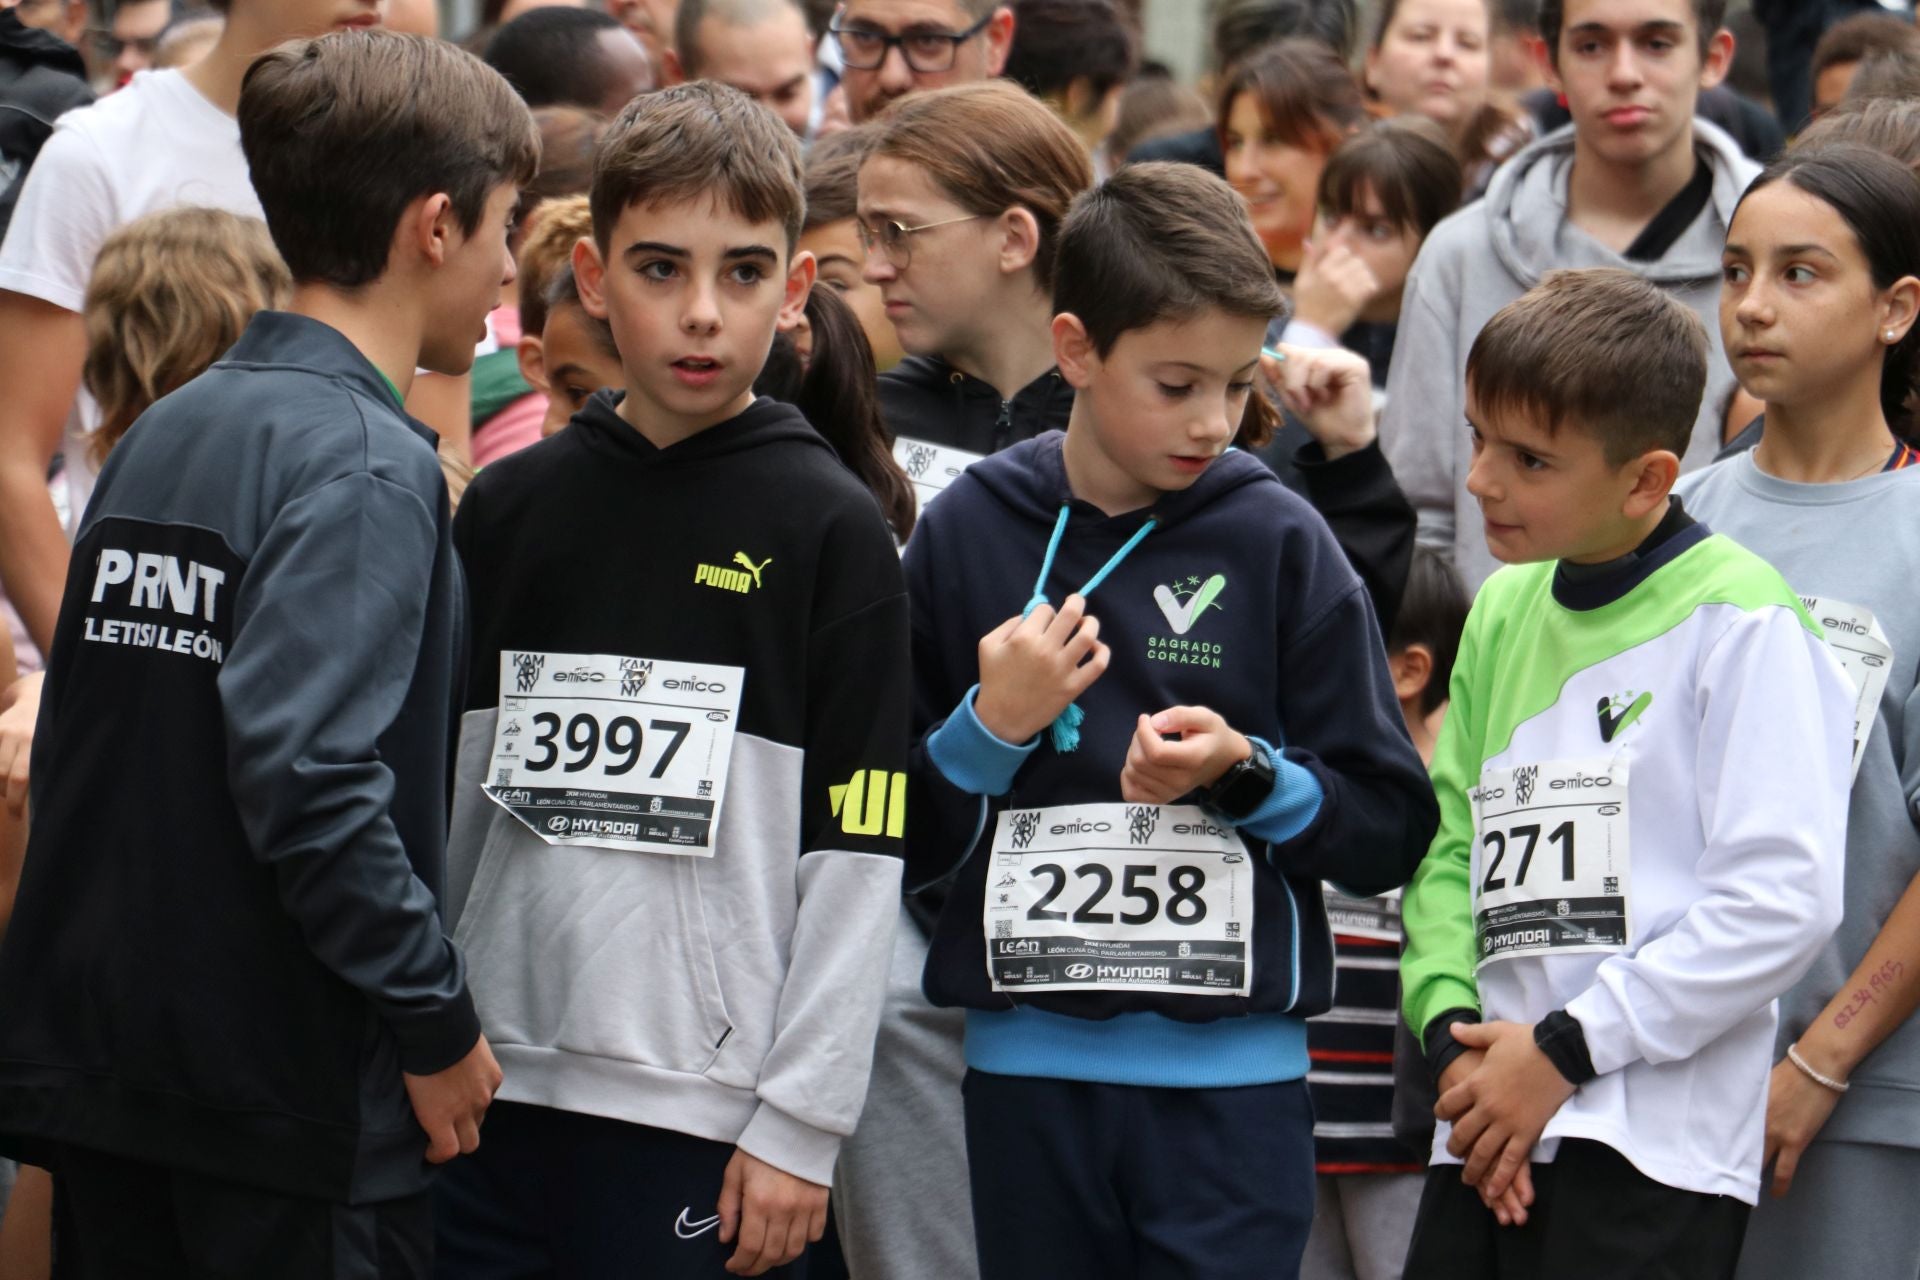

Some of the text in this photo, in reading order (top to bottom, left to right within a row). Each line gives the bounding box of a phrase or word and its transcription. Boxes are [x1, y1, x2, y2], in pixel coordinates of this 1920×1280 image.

[695, 564, 752, 593] PUMA
[1822, 618, 1868, 635] emic
[1148, 637, 1221, 654] SAGRADO
[513, 653, 545, 668] KAM
[619, 658, 653, 674] KAM
[1147, 650, 1220, 668] CORAZÓN
[553, 667, 605, 682] emico
[663, 676, 726, 693] emico
[525, 712, 691, 779] 3997
[1513, 765, 1538, 781] KAM
[1550, 772, 1612, 789] emico
[579, 801, 639, 811] PARLAMENTARISMO
[1125, 806, 1160, 820] KAM
[572, 819, 639, 835] HYUNDAI
[1050, 818, 1111, 835] emico
[1477, 821, 1574, 897] 271
[1027, 863, 1207, 926] 2258
[1495, 929, 1550, 947] HYUNDAI
[1097, 965, 1170, 979] HYUNDAI
